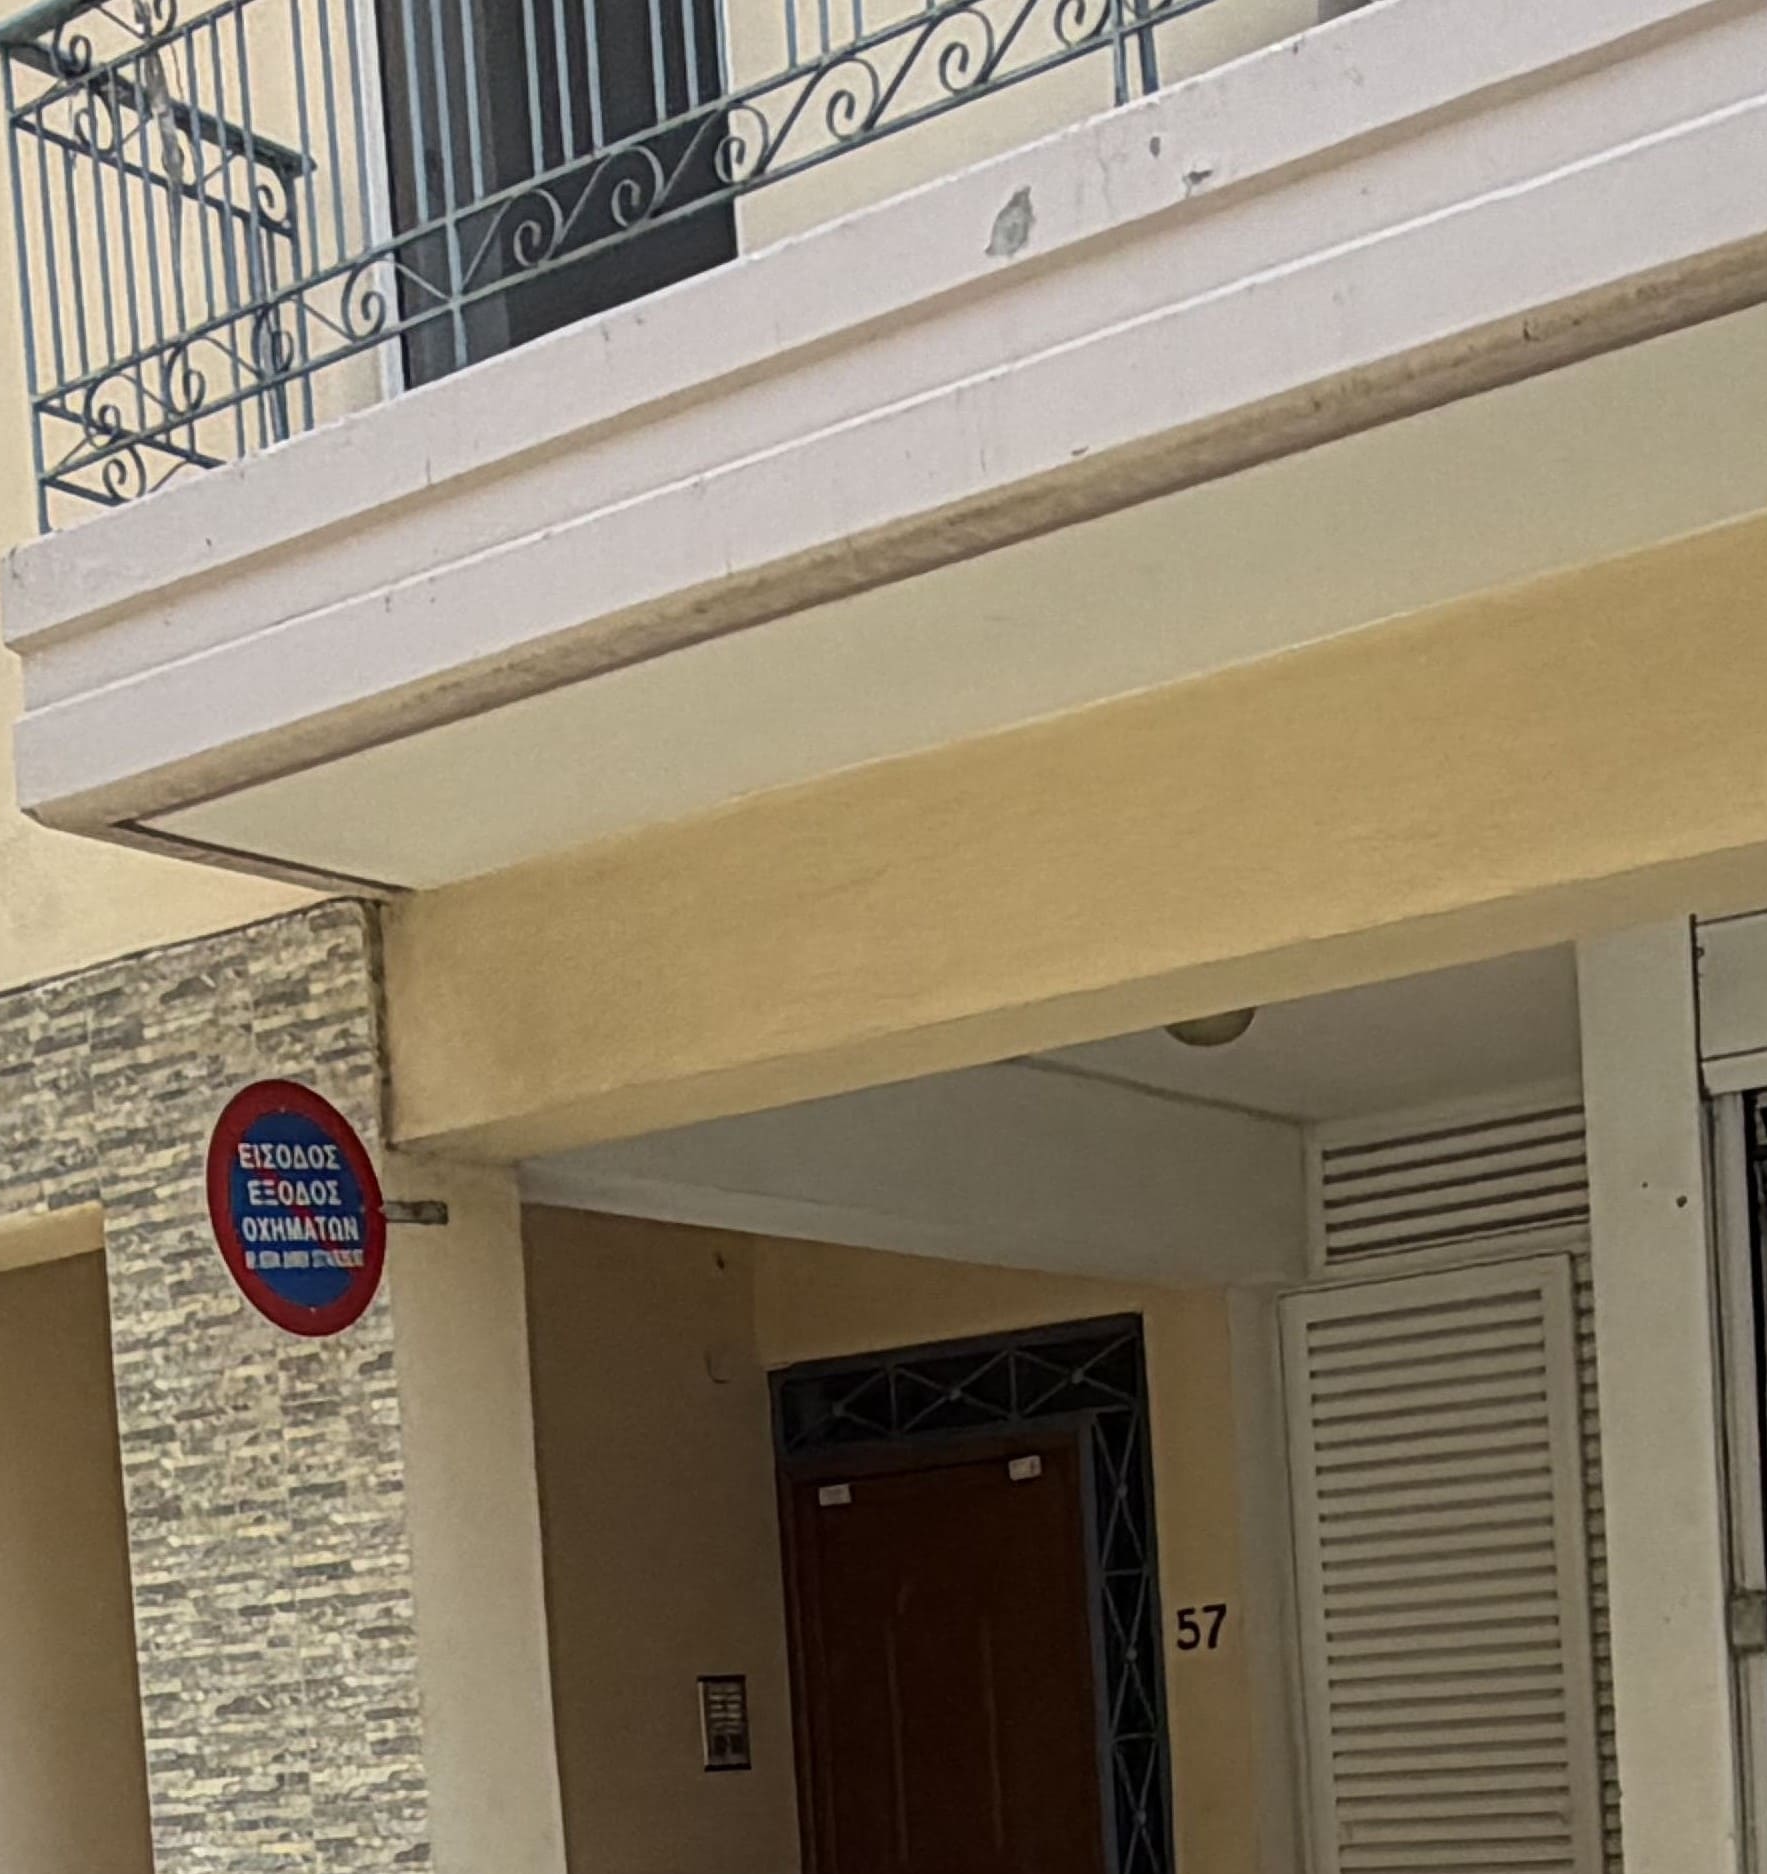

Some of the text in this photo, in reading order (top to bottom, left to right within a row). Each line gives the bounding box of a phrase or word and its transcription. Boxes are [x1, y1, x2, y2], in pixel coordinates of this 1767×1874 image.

[237, 1142, 342, 1170] ΕΙΣΟΔΟΣ
[247, 1179, 343, 1206] ΕΞΟΔΟΣ
[241, 1215, 360, 1242] ΟΧΗΜΑΤΩΝ
[1176, 1603, 1227, 1651] 57
